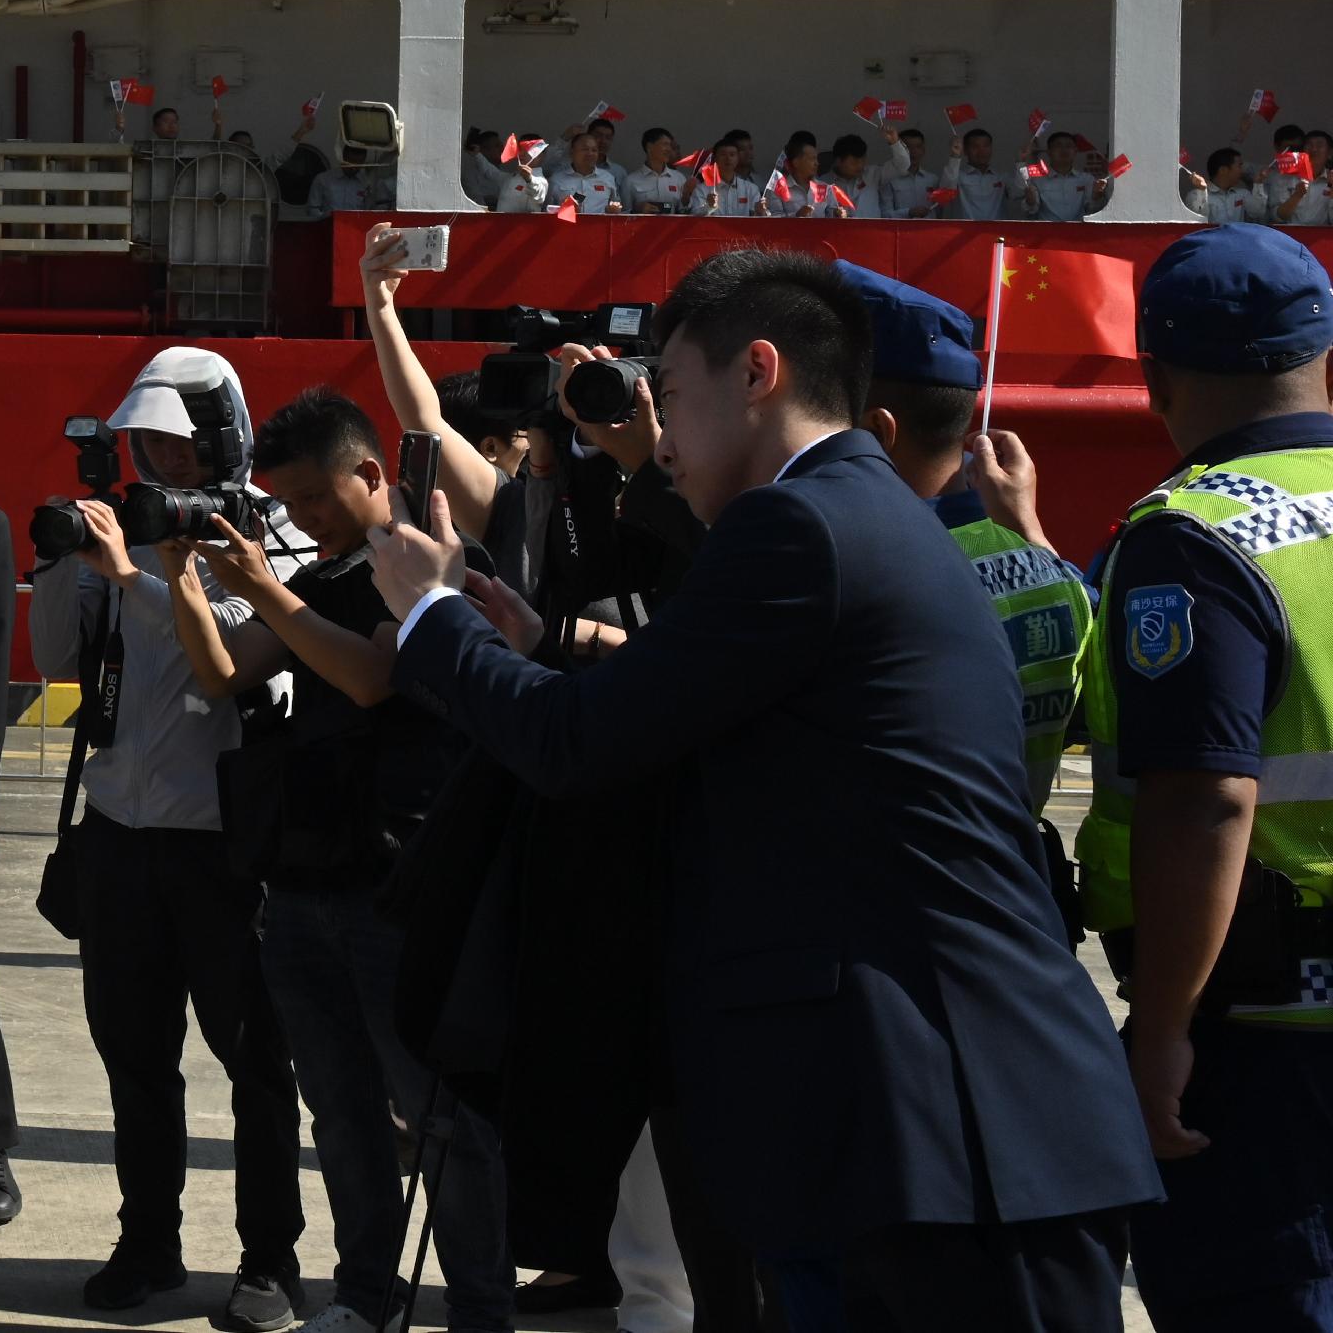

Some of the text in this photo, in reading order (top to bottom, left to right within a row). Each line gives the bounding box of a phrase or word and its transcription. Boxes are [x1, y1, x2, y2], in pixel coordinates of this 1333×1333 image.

[564, 507, 579, 557] SONY
[1131, 595, 1178, 611] 南沙安保
[104, 674, 117, 720] SONY
